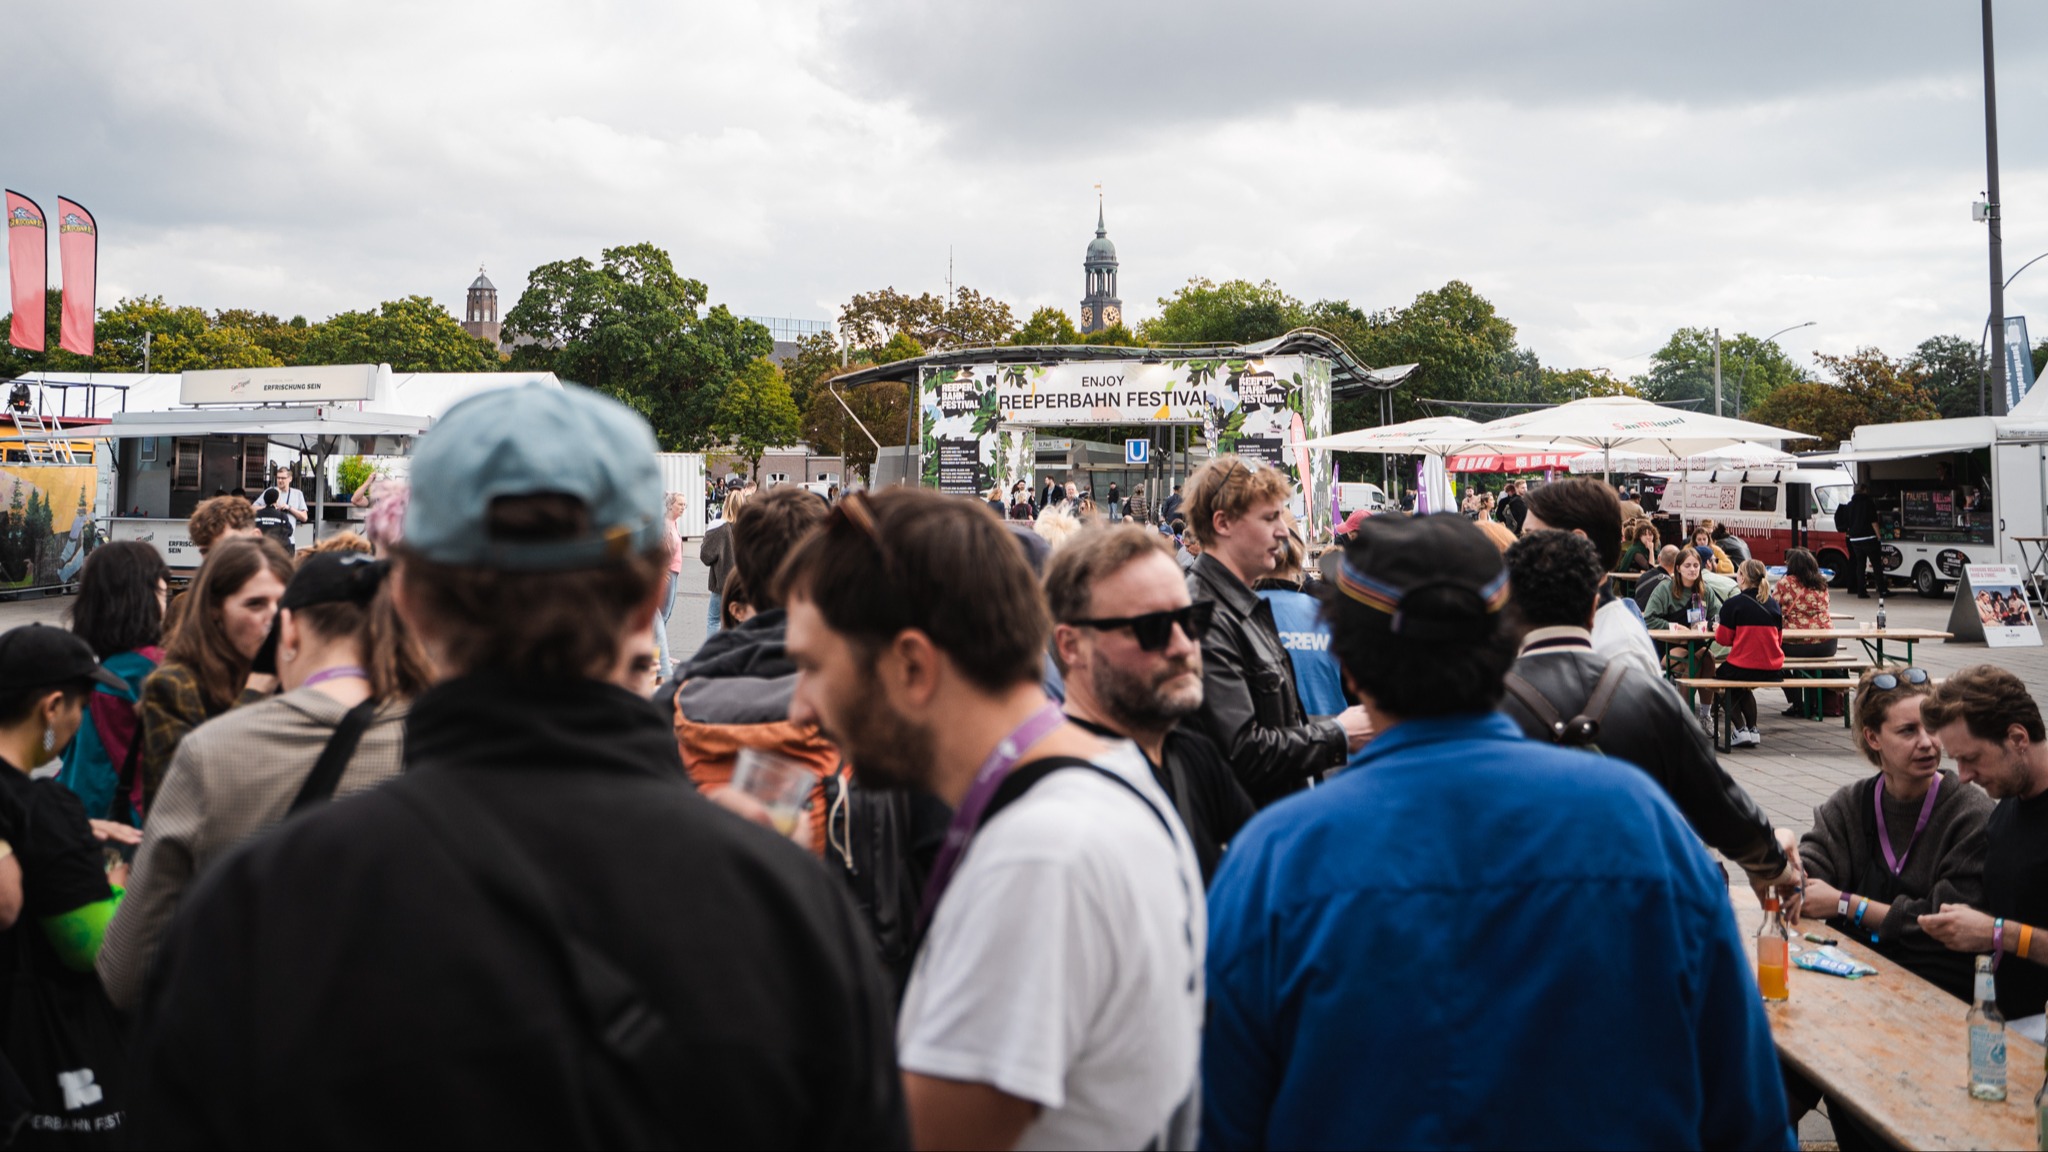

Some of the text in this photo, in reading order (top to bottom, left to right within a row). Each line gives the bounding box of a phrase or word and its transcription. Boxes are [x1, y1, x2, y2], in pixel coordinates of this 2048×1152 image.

[1082, 375, 1125, 388] ENJOY
[263, 383, 306, 391] ERFRISCHUNG
[942, 383, 973, 391] REEPER
[942, 391, 965, 400] BAHN
[1000, 390, 1213, 410] REEPERBAHN FESTIVAL
[1239, 394, 1285, 404] FESTIVAL
[942, 400, 980, 410] FESTIVAL
[1129, 441, 1145, 461] U
[168, 540, 200, 548] ERFRISC
[1278, 631, 1331, 652] CREW
